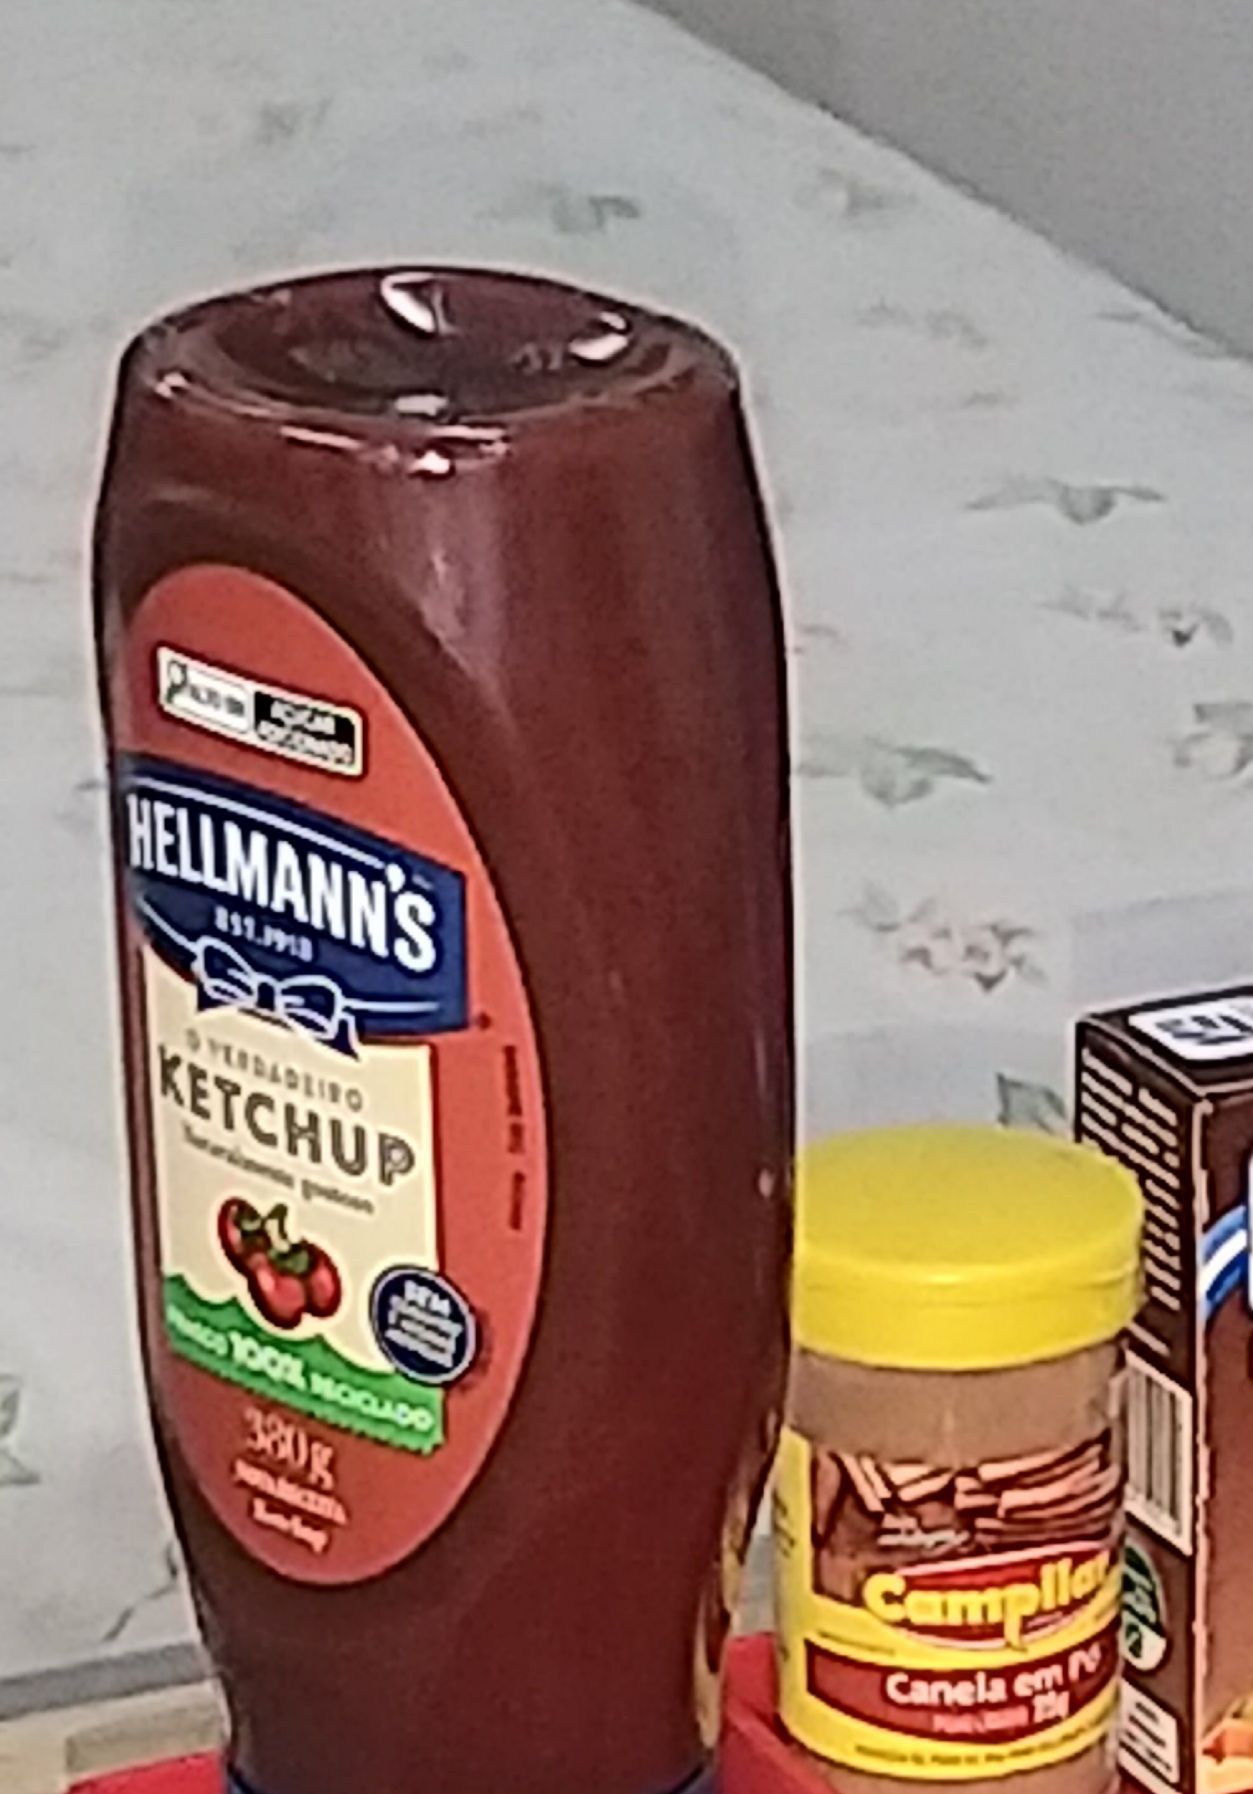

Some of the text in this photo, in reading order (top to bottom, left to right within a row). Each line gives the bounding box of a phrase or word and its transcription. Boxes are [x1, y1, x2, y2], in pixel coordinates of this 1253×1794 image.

[126, 793, 437, 973] HELLMANN'S
[157, 1043, 416, 1187] KETCHUP
[207, 1036, 364, 1112] VERDADEIRO
[885, 1672, 1008, 1707] Canela
[1013, 1663, 1064, 1698] em
